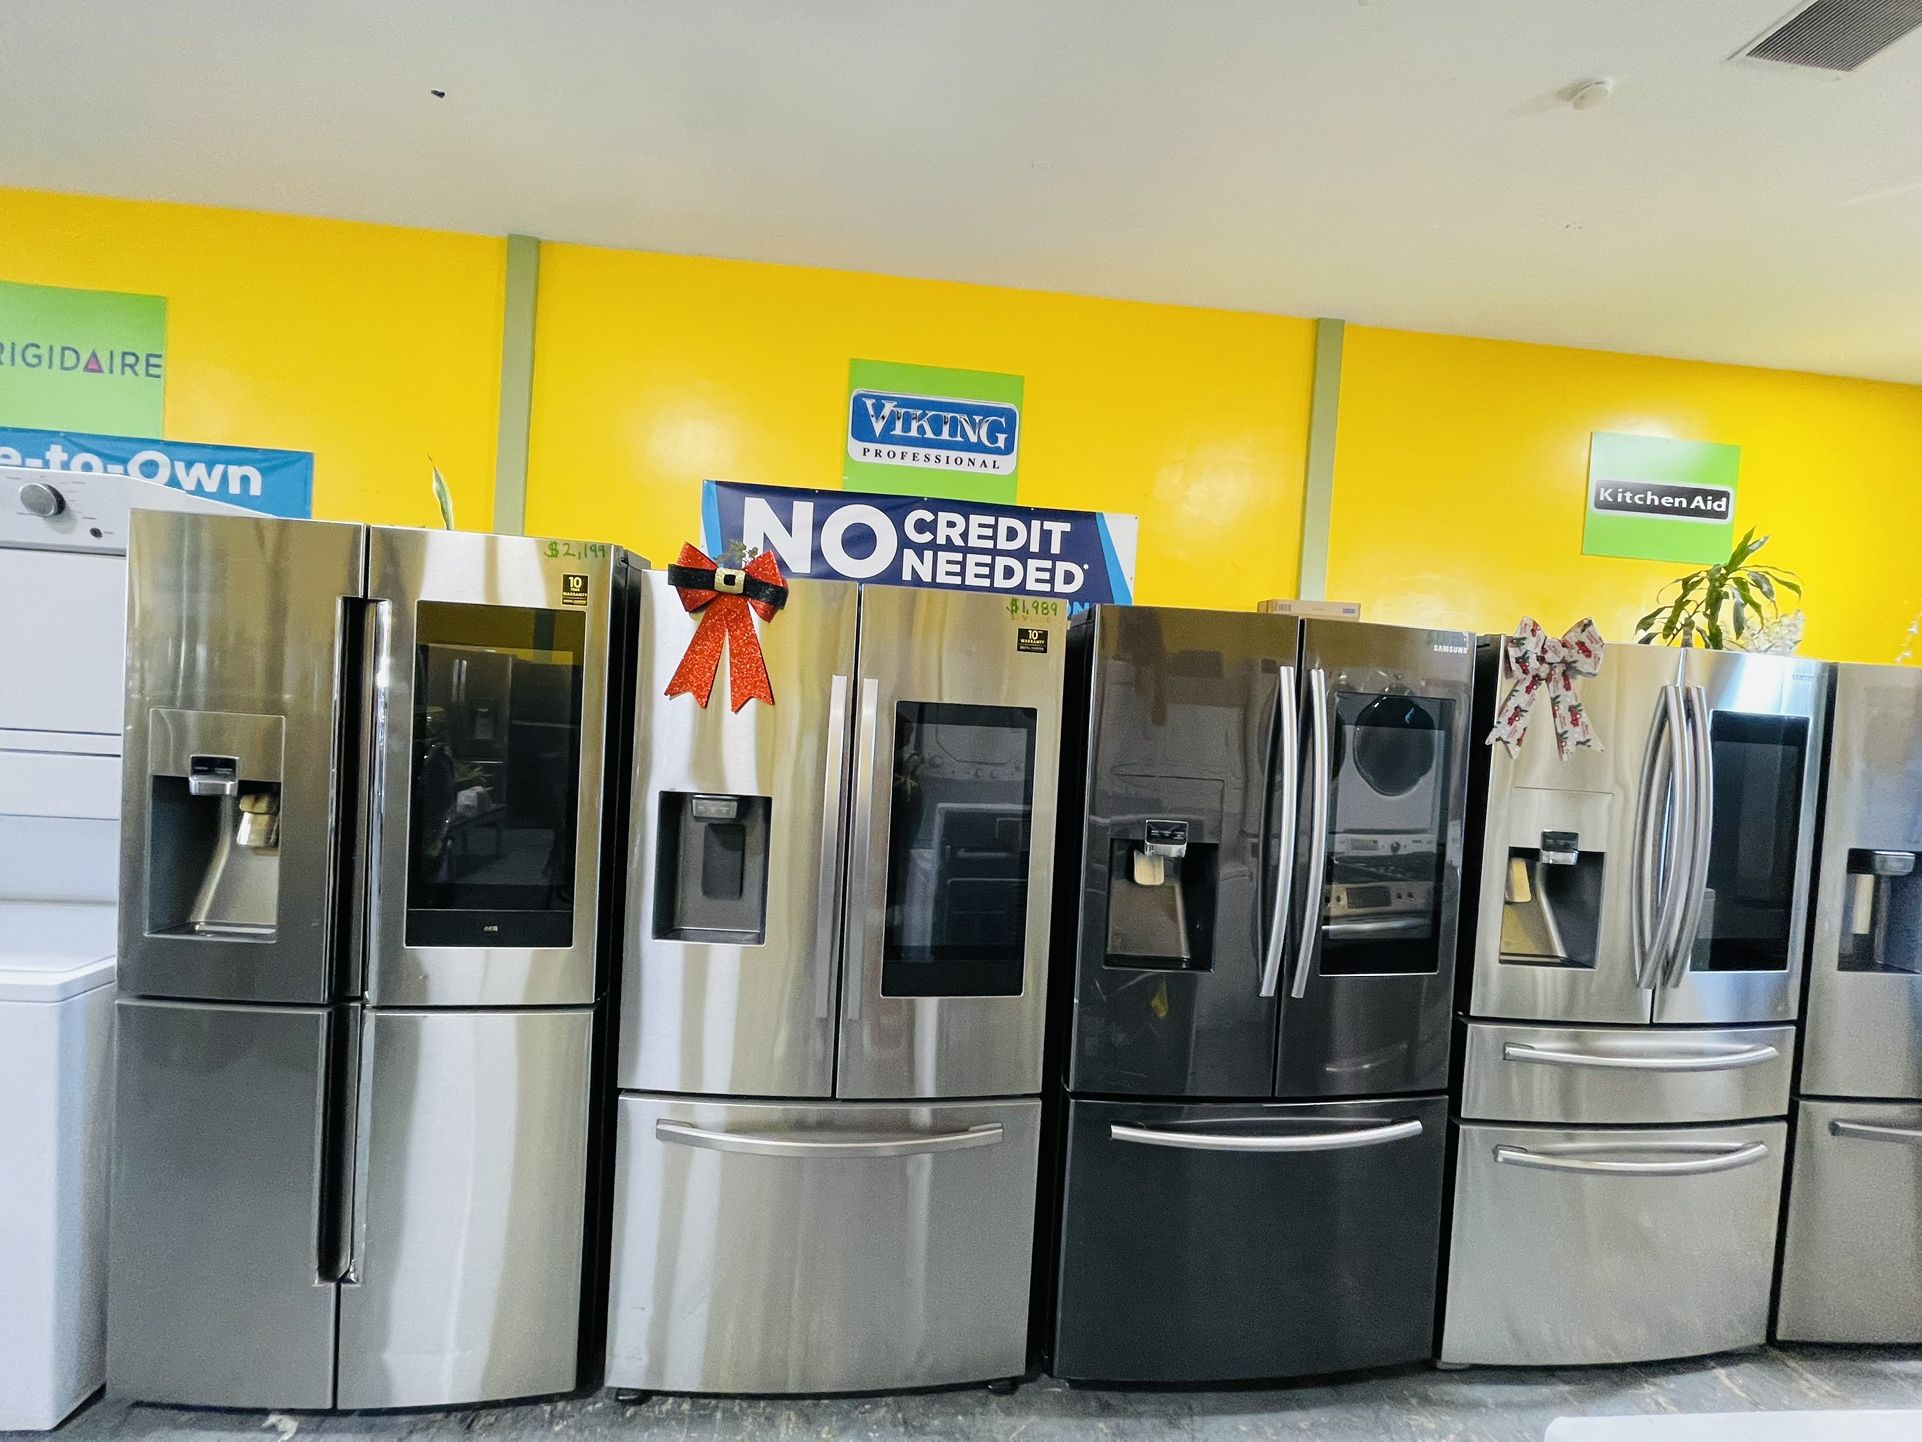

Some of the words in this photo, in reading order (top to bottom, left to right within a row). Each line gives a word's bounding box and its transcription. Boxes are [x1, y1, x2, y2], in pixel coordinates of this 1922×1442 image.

[0, 341, 163, 379] IGIDAIRE
[862, 397, 1008, 450] VIKING
[862, 447, 1000, 470] PROFESSIONAL
[741, 497, 898, 579] NO
[903, 509, 1071, 554] CREDIT
[544, 541, 606, 560] $2,199
[568, 576, 582, 588] 10
[1006, 597, 1058, 616] $1,989
[1028, 630, 1038, 640] 10
